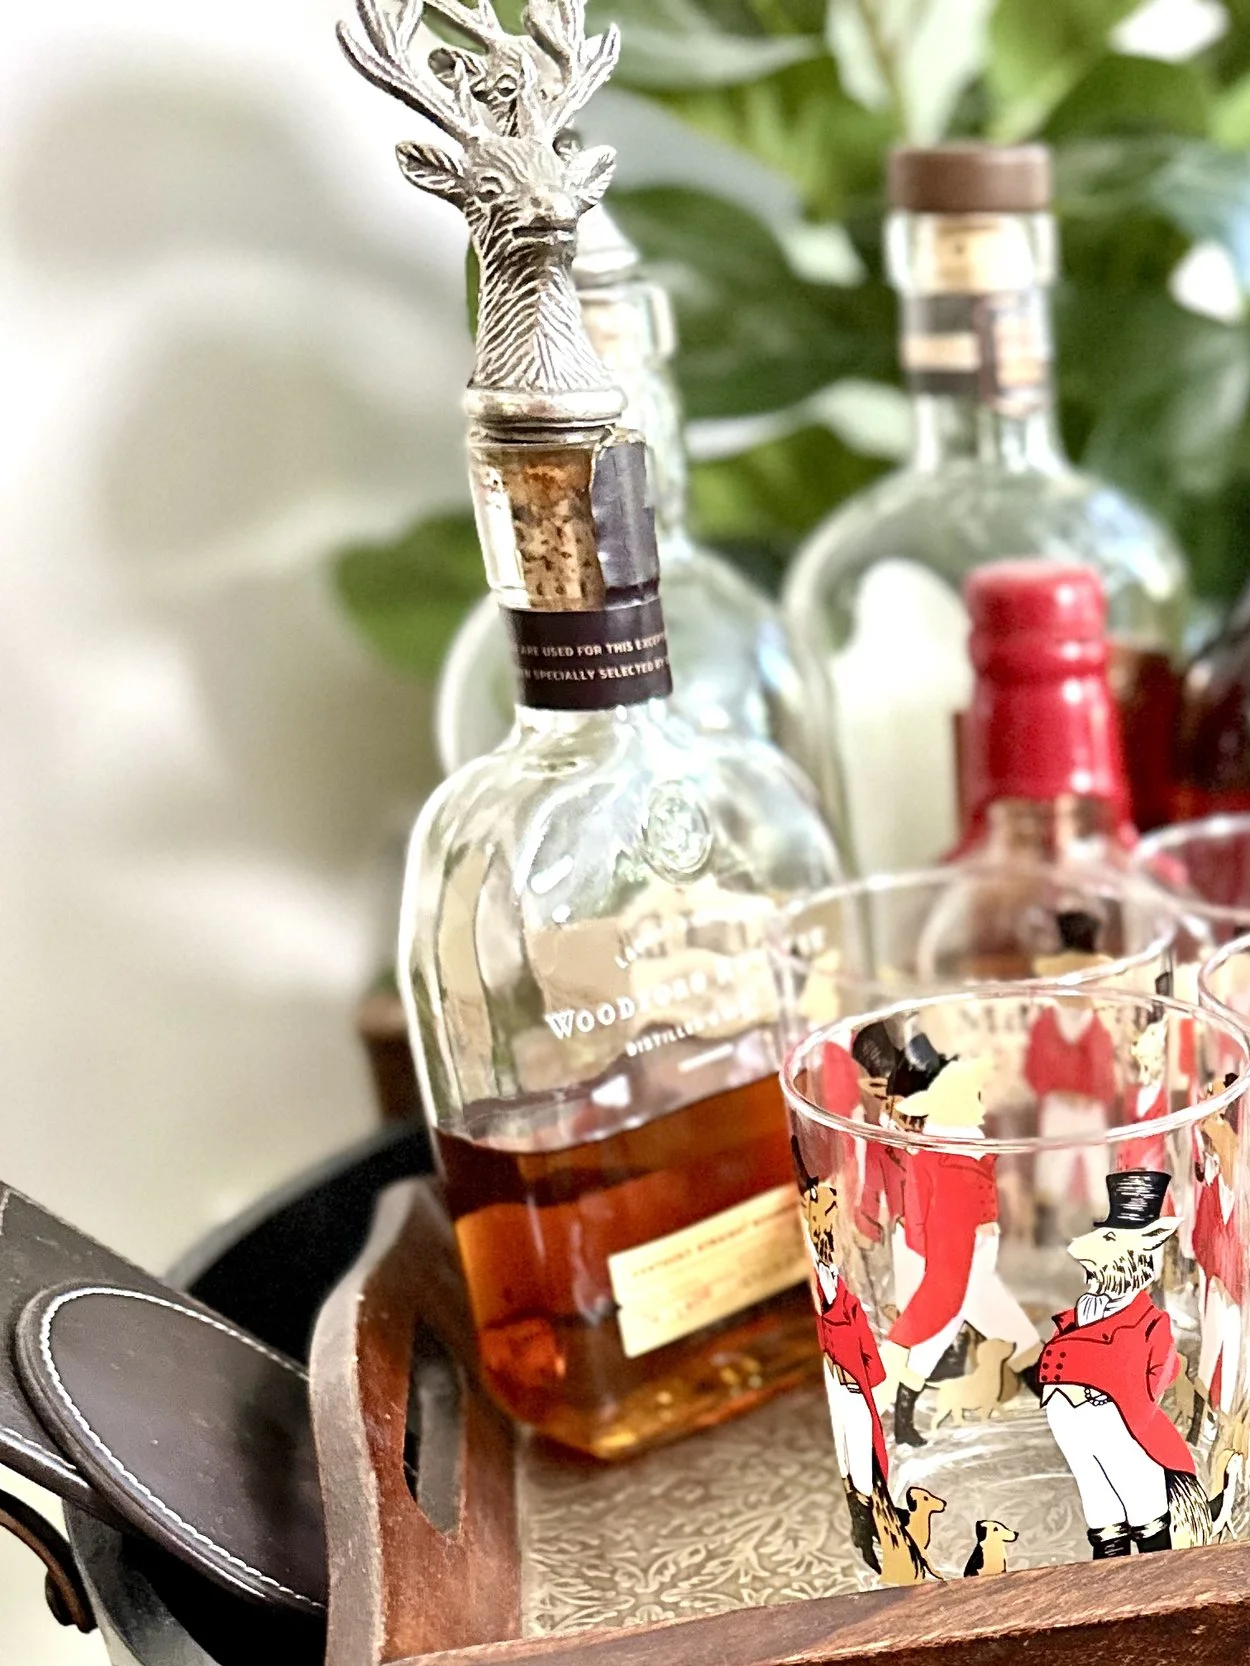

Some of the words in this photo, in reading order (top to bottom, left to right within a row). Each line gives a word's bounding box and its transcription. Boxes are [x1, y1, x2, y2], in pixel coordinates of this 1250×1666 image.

[542, 645, 575, 657] USED
[577, 644, 603, 656] FOR
[605, 640, 634, 653] THIS
[533, 669, 596, 681] SPECIALLY
[599, 660, 654, 680] SELECTED
